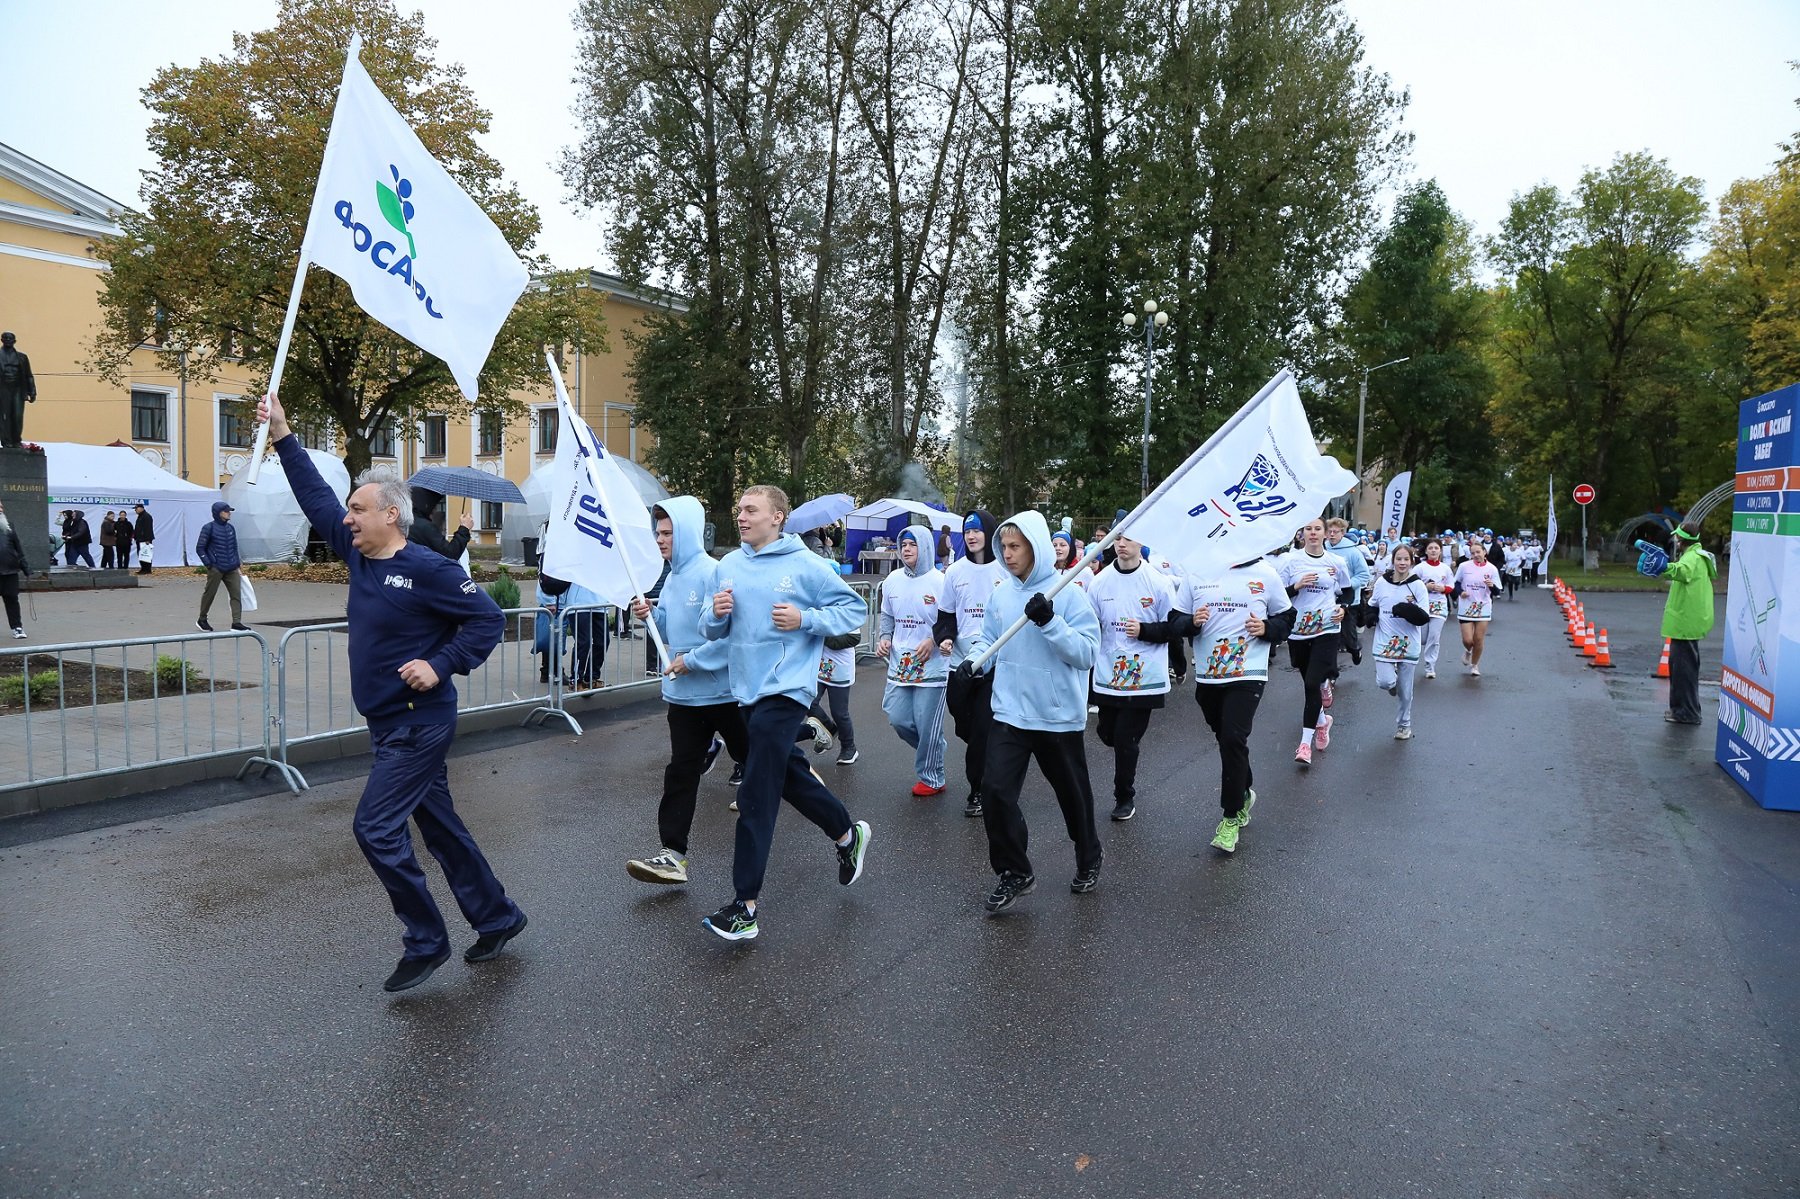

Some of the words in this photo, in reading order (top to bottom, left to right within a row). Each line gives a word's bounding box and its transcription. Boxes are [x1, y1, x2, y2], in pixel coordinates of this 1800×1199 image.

[1754, 442, 1773, 460] ЗАБЕГ
[53, 496, 94, 504] ЖЕНСКАЯ
[95, 497, 145, 505] РАЗДЕВАЛКА
[1391, 489, 1402, 528] САГРО
